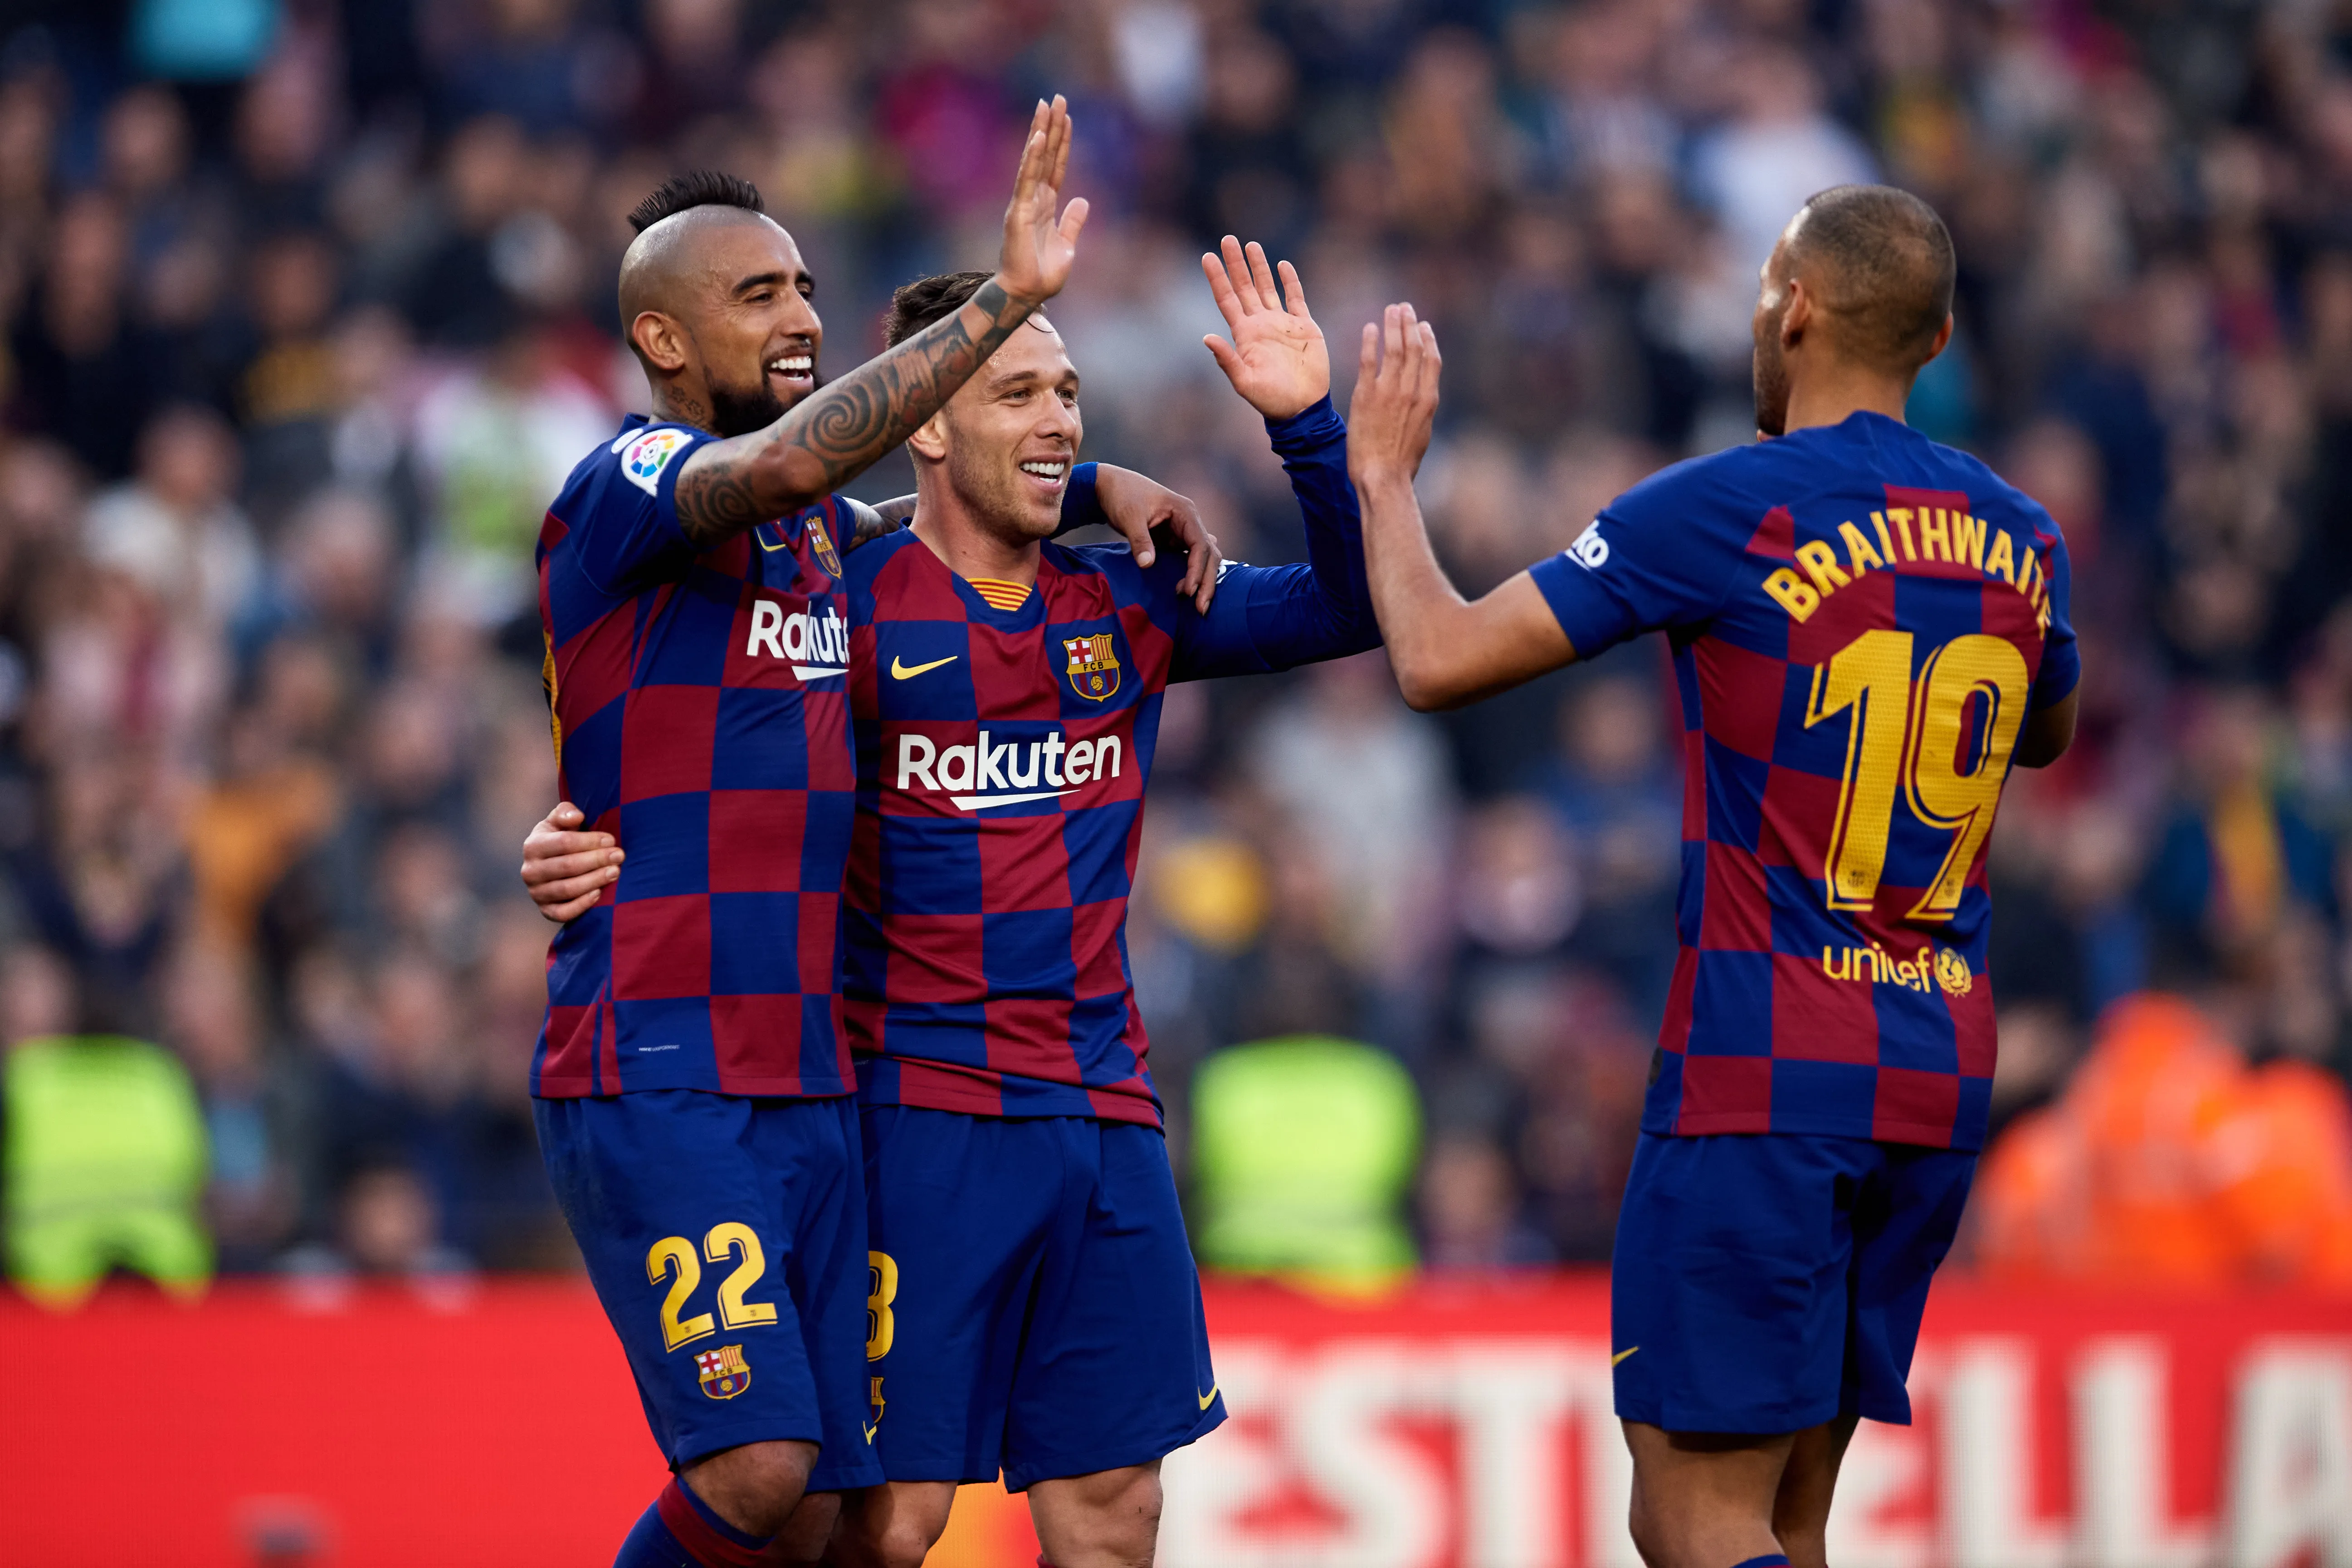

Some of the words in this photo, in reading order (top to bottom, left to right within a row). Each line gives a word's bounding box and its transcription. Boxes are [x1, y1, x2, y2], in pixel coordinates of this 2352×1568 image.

[1083, 661, 1104, 672] FCB
[897, 730, 1121, 791] Rakuten
[1804, 629, 2029, 920] 19
[1823, 941, 1931, 993] unicef
[645, 1221, 778, 1353] 22
[712, 1368, 733, 1378] FCB
